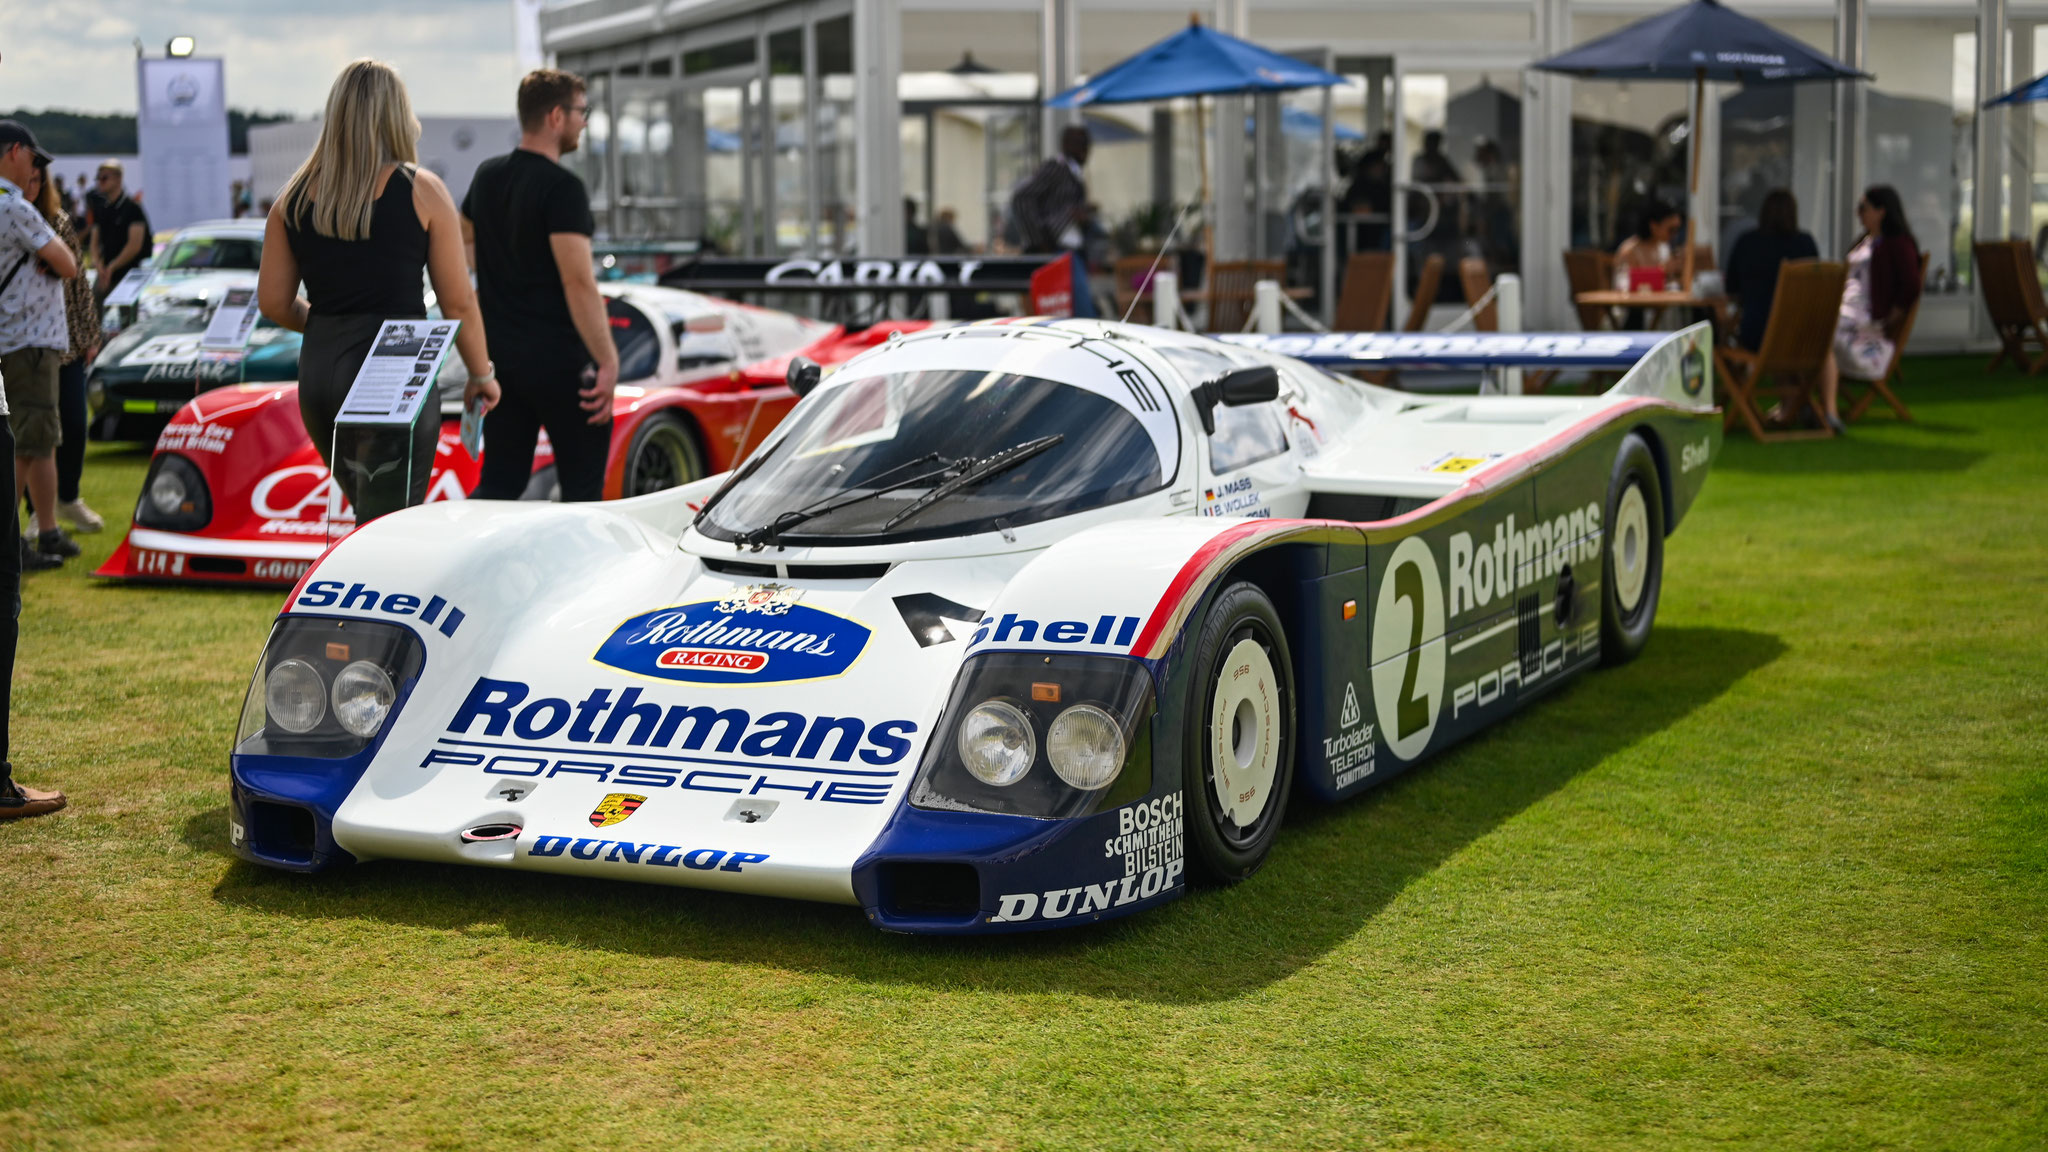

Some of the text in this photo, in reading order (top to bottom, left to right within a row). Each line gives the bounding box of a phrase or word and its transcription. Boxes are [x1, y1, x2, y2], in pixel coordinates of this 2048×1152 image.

[1224, 477, 1252, 495] MASS
[1449, 502, 1600, 618] Rothmans
[297, 581, 466, 638] Shell
[626, 612, 836, 656] Rothmans
[1394, 560, 1430, 742] 2
[671, 652, 753, 668] RACING
[1453, 619, 1600, 720] PORSCHE
[447, 676, 918, 765] Rothmans
[1323, 722, 1375, 758] Turbolader
[419, 749, 893, 805] PORSCHE
[1330, 741, 1375, 775] TELETRON
[1119, 790, 1184, 836] BOSCH
[528, 836, 770, 873] DUNLOP
[1105, 816, 1184, 858] SCHMITTHELM
[1125, 833, 1184, 877] BILSTEIN
[991, 857, 1185, 923] DUNLOP
